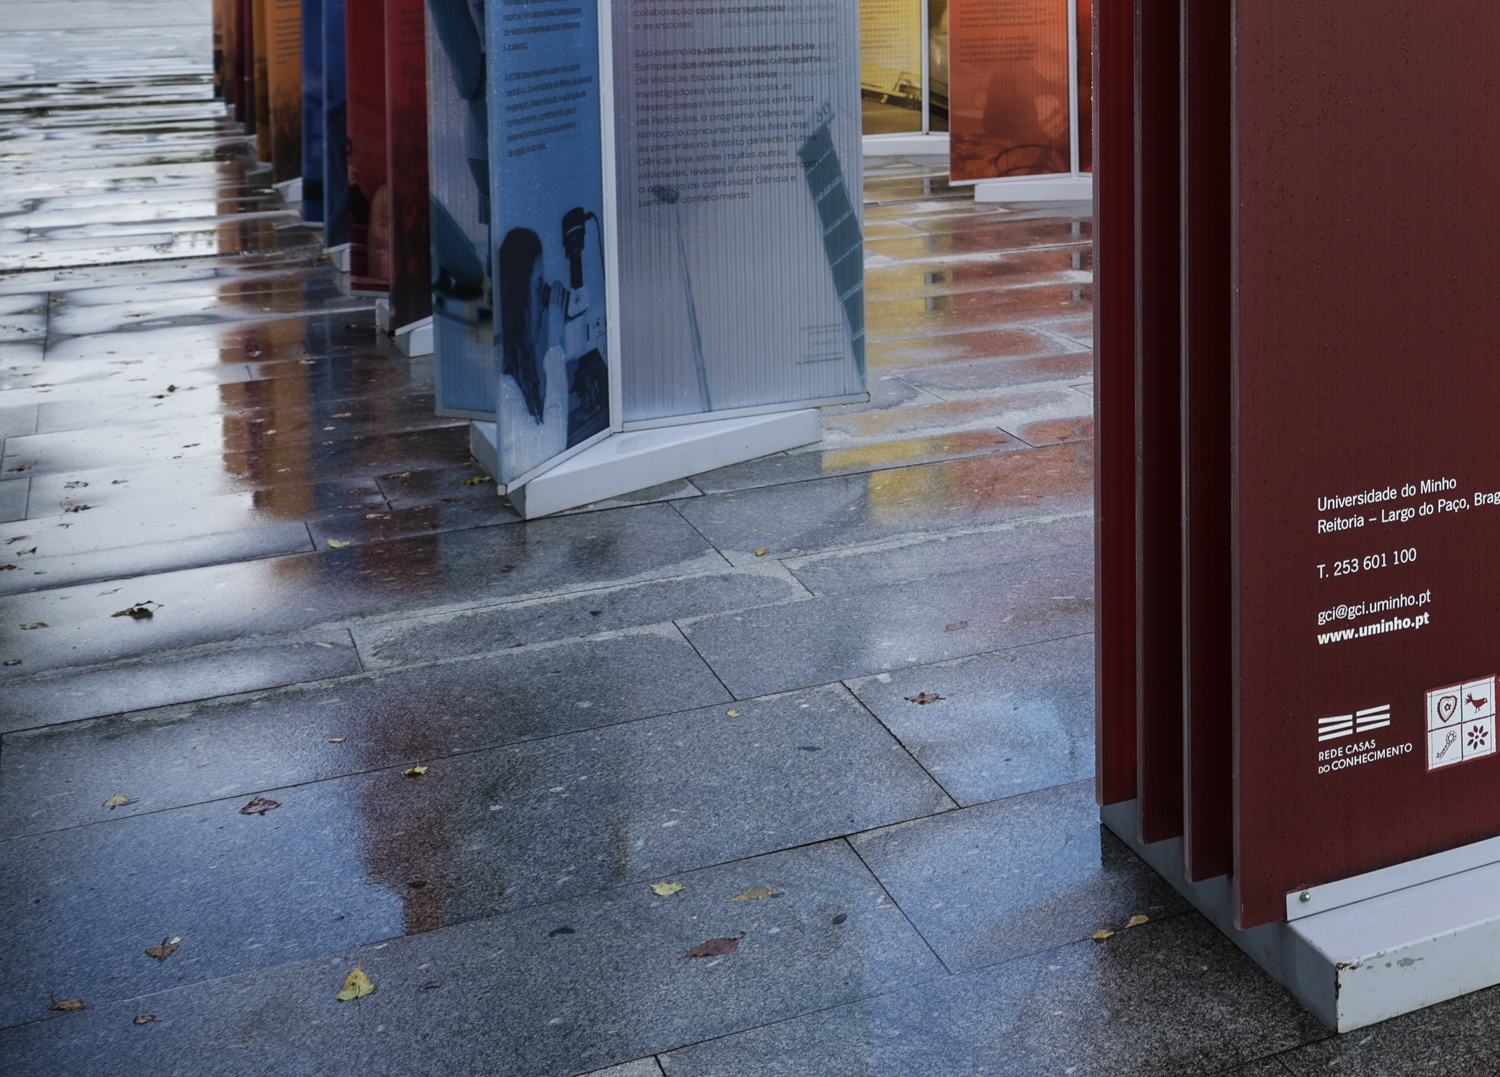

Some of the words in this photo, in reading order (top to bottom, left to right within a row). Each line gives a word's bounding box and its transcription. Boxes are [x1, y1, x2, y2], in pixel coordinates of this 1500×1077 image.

[1317, 486, 1398, 511] Universidade
[1401, 483, 1416, 498] do
[1420, 477, 1457, 495] Minho
[1318, 514, 1365, 534] Reitoria
[1381, 505, 1415, 523] Largo
[1419, 502, 1434, 517] do
[1438, 498, 1470, 513] Paço,
[1317, 564, 1329, 579] T.
[1333, 558, 1359, 577] 253
[1363, 553, 1387, 570] 601
[1393, 547, 1417, 565] 100
[1317, 589, 1431, 625] gci@gci.uminho.pt
[1317, 611, 1430, 645] www.uminho.pt
[1318, 747, 1343, 762] REDE
[1345, 739, 1376, 756] CASAS
[1318, 764, 1330, 774] DO
[1331, 742, 1413, 771] CONHECIMENTO
